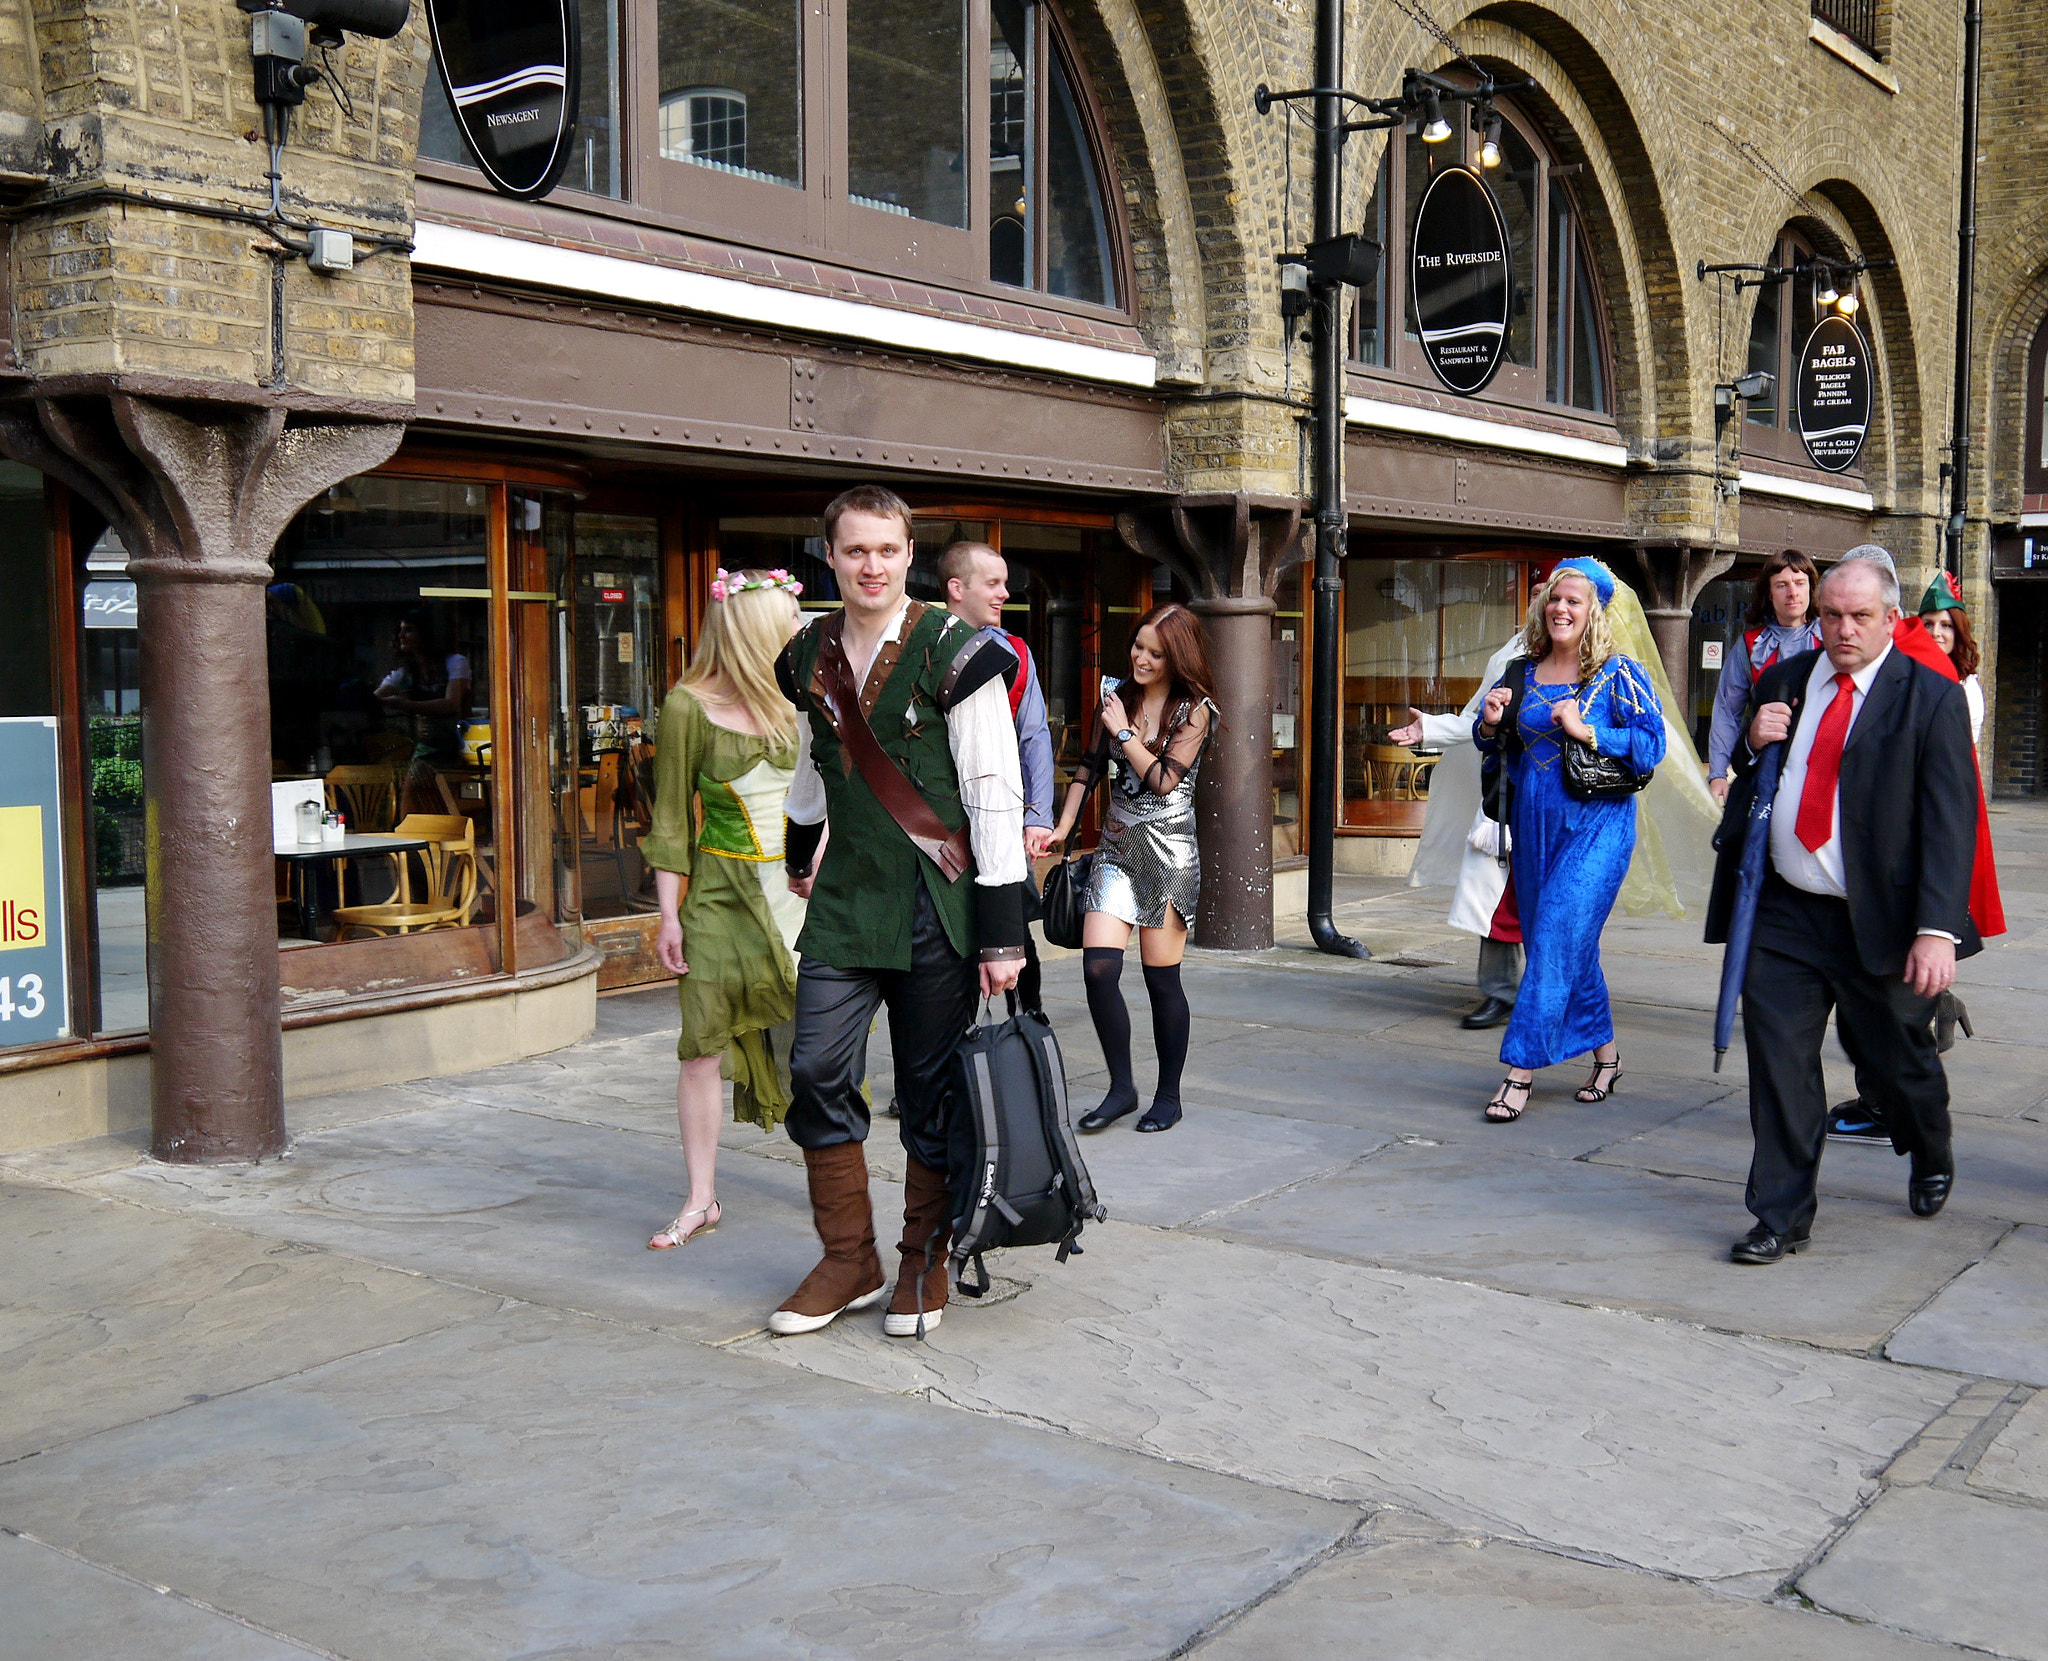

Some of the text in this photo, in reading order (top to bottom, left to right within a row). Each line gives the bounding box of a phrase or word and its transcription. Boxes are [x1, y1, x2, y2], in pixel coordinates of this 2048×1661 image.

[486, 109, 540, 127] NEWSAGENT
[1417, 250, 1501, 268] THE RIVERSIDE
[1440, 346, 1479, 354] RESTAURANT
[1822, 345, 1845, 355] FAB
[1440, 355, 1489, 365] SANDWICH BAR
[1811, 356, 1856, 368] BAGELS
[1815, 373, 1851, 382] DELICIOUS
[1820, 382, 1846, 390] BAGELS
[1818, 390, 1847, 398] PANNINI
[1813, 398, 1852, 407] ICE CREAM
[1835, 439, 1856, 447] COLD
[1814, 448, 1854, 456] BEVERAGES
